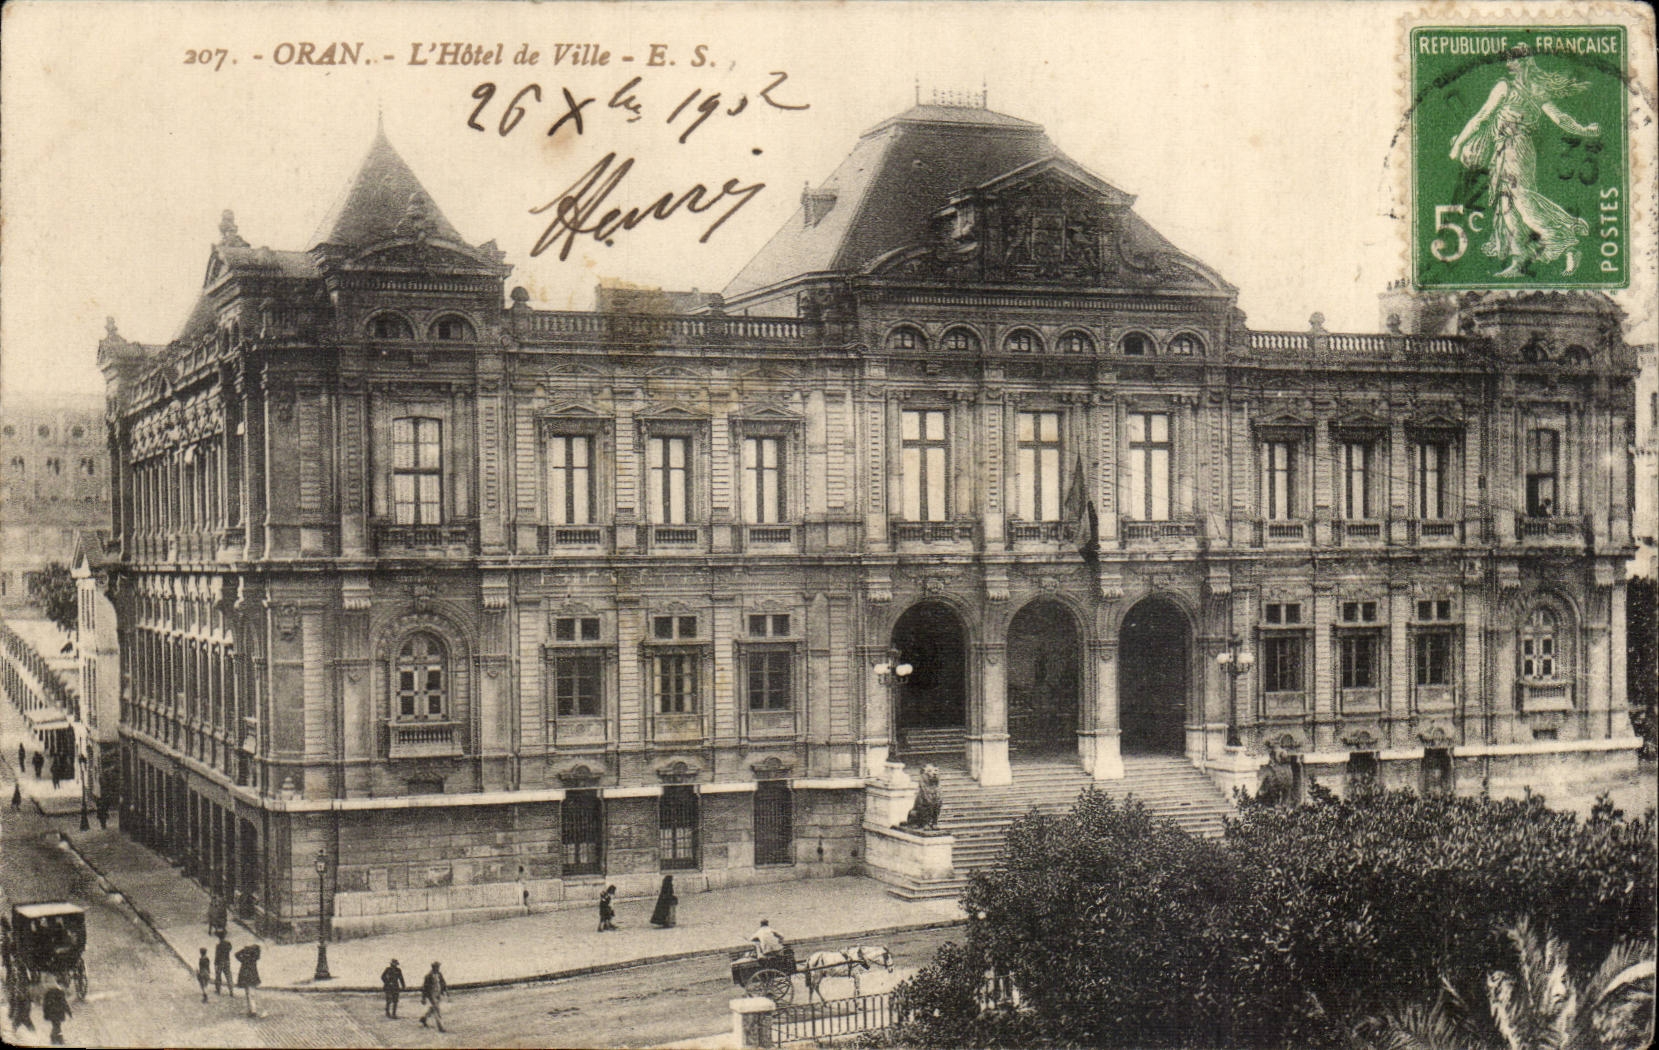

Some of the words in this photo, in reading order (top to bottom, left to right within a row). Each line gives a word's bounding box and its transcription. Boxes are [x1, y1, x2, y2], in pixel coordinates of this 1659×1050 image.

[1535, 35, 1618, 55] FRANÇAISE
[466, 82, 542, 138] 26
[1599, 186, 1620, 273] POSTES
